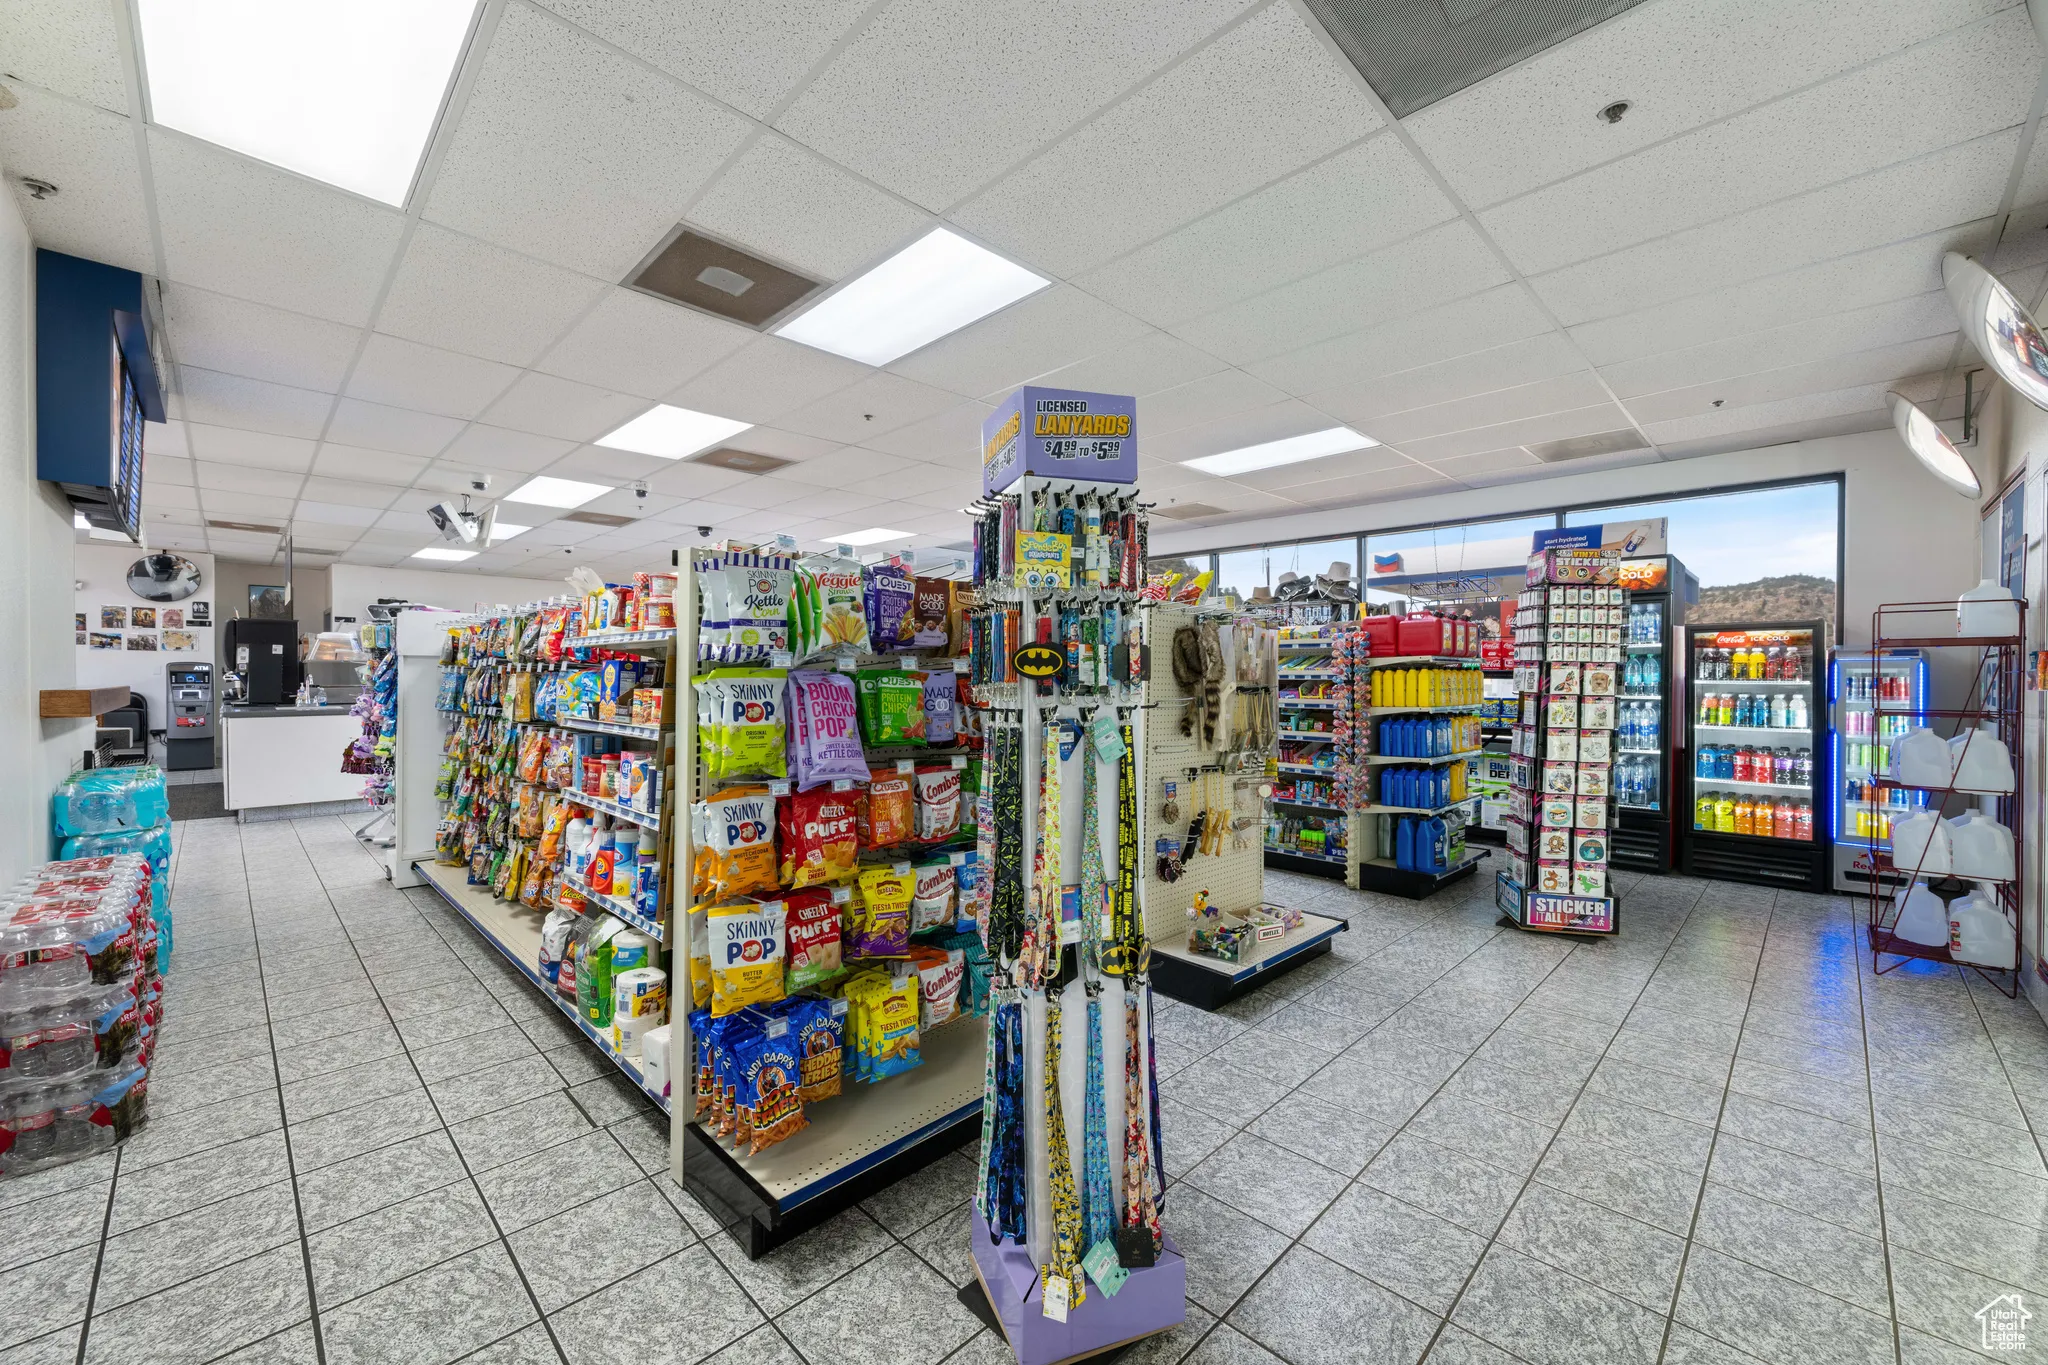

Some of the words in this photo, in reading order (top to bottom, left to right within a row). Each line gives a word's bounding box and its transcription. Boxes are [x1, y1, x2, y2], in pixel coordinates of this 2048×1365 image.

[1037, 401, 1087, 412] LICENSED
[1034, 415, 1131, 436] LANYARDS
[984, 412, 1020, 464] LANYARDS
[1079, 447, 1089, 456] TO
[1558, 535, 1587, 543] hydrated
[812, 572, 862, 589] Veggie
[880, 576, 912, 590] QUEST
[1620, 570, 1653, 580] COLD
[748, 578, 778, 594] POP
[744, 594, 784, 610] Kettle
[881, 595, 908, 606] PROTEIN
[919, 593, 945, 601] MADE
[919, 600, 945, 610] GOOD
[752, 606, 780, 618] Corn
[881, 605, 904, 617] CHIPS
[880, 676, 917, 686] QUEST
[807, 683, 854, 702] BOOM
[881, 693, 912, 703] PROTEIN
[924, 687, 953, 699] MADE
[733, 700, 775, 723] POP
[811, 702, 857, 718] CHICKA
[881, 703, 908, 714] CHIPS
[814, 717, 847, 740] POP
[818, 750, 845, 759] KETTLE
[873, 782, 905, 792] QUEST
[926, 773, 960, 800] Combos
[726, 821, 767, 846] POP
[807, 867, 826, 875] DOUBLE
[807, 872, 827, 880] CHEESE
[1123, 892, 1133, 915] BATMAN
[1536, 897, 1606, 917] STICKER
[798, 904, 829, 921] CHEEZ-IT
[727, 938, 777, 965] POP
[742, 969, 763, 978] BUTTER
[926, 962, 964, 997] Combos
[816, 1017, 843, 1036] CAPP'S
[763, 1051, 796, 1070] CAPP'S
[805, 1062, 840, 1084] FRIES
[754, 1082, 795, 1113] HOT
[753, 1094, 800, 1128] FRIES
